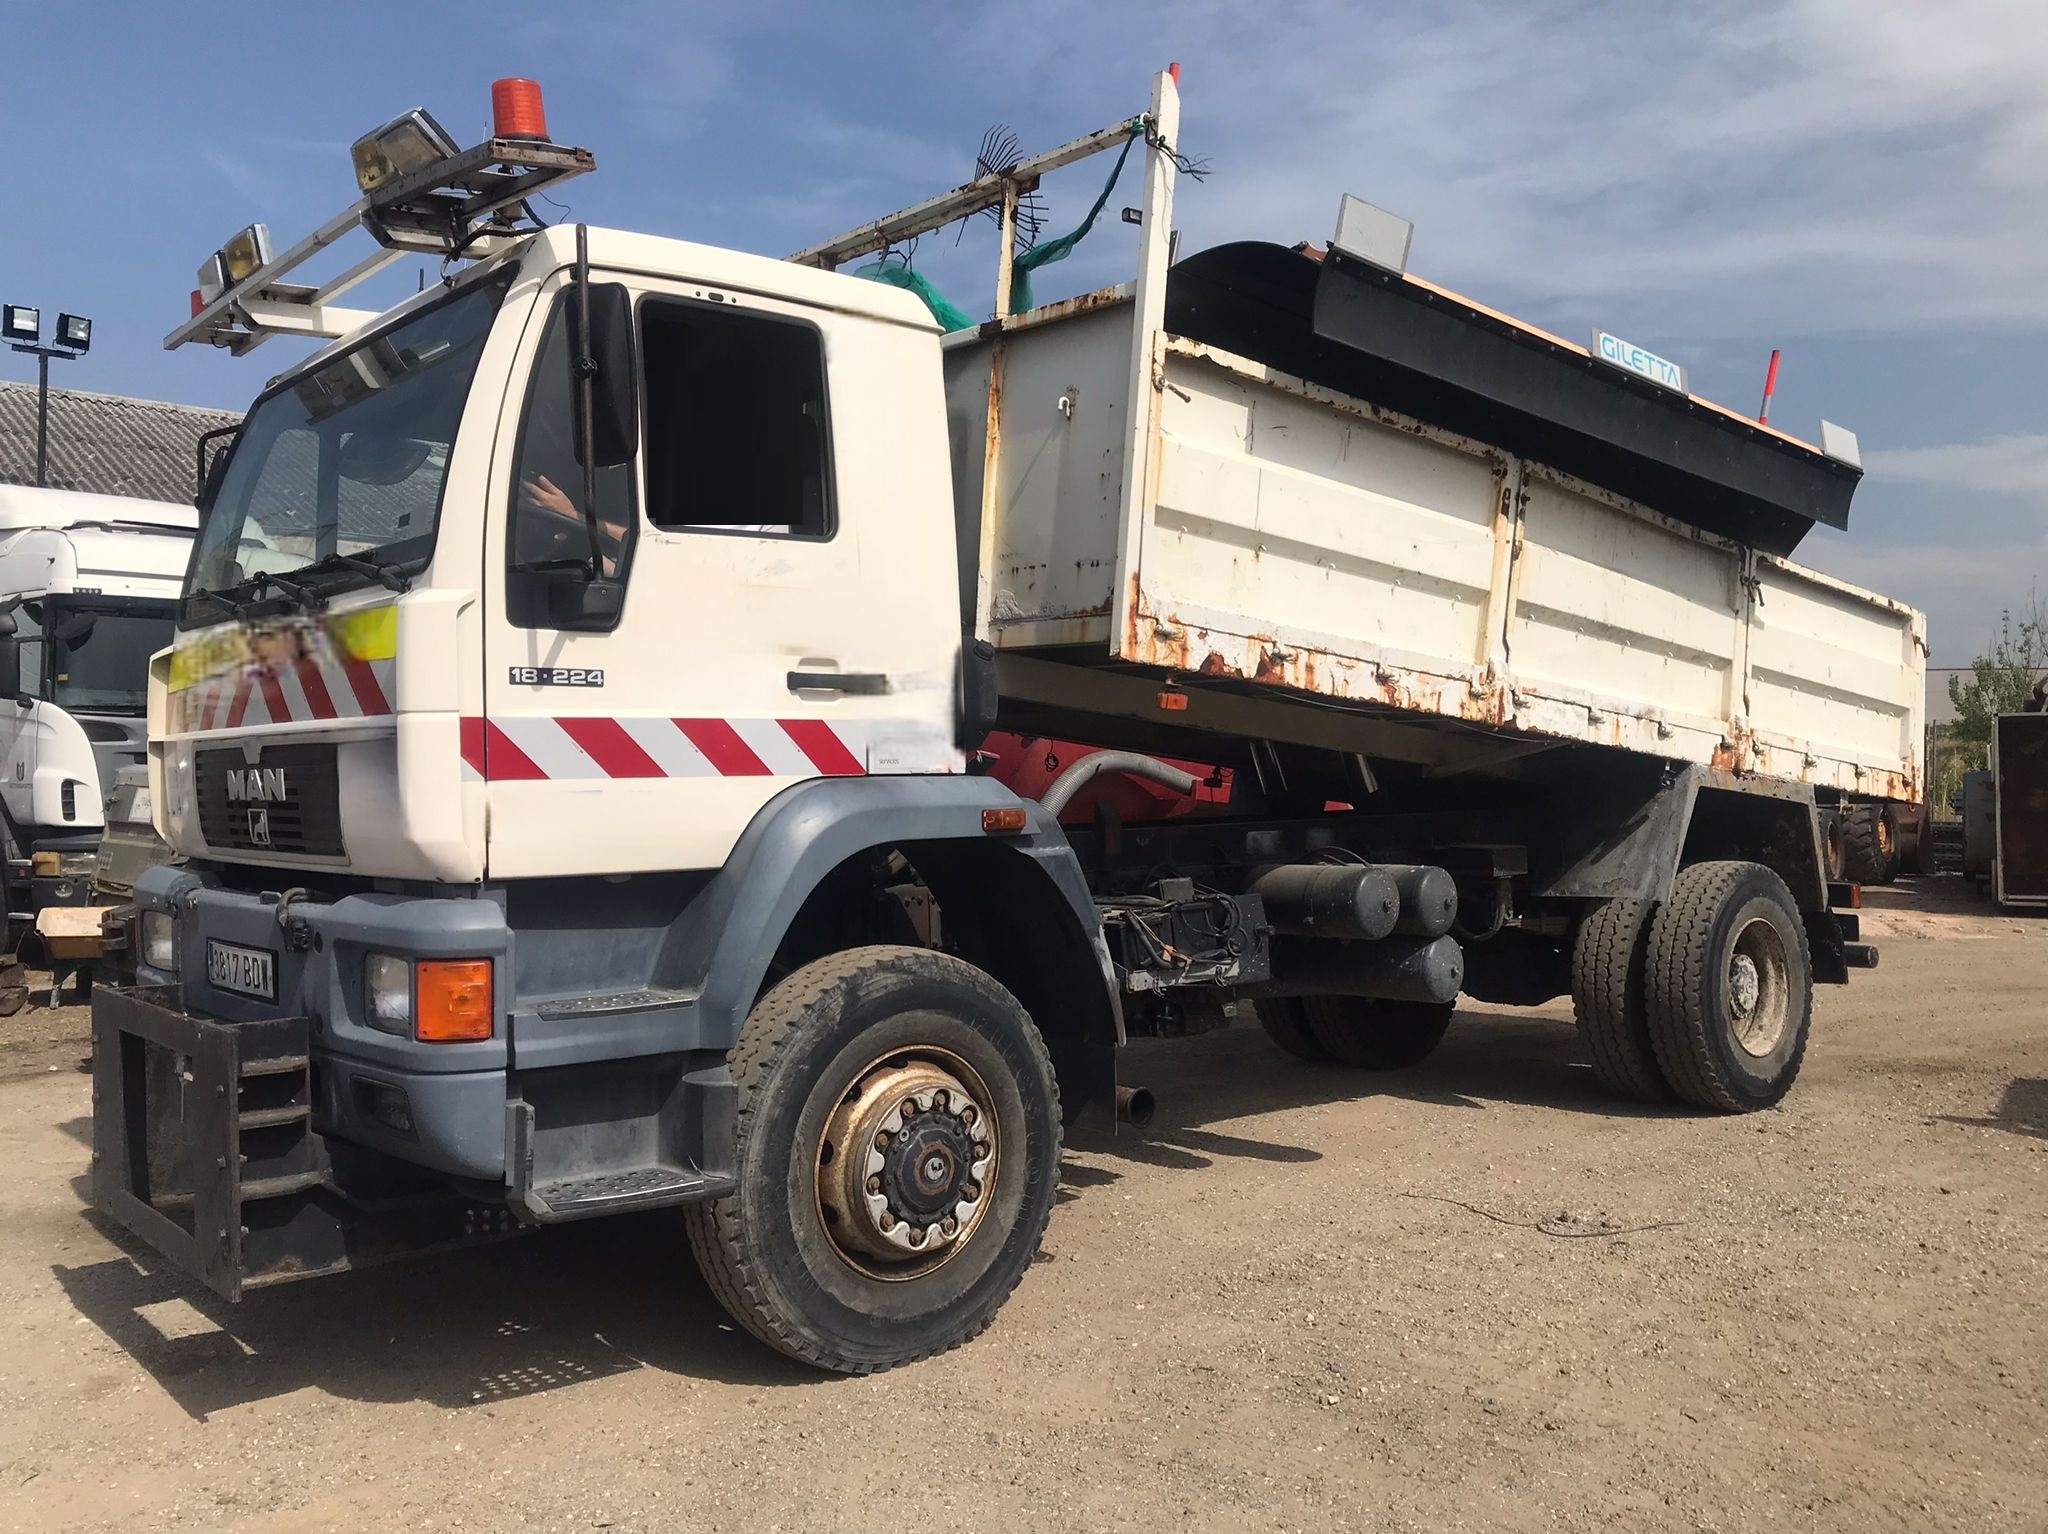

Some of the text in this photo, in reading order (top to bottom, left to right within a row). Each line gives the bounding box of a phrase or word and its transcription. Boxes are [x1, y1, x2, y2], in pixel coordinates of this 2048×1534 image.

[1602, 336, 1680, 388] GILETTA
[227, 768, 286, 801] MAN
[213, 949, 240, 984] 3817
